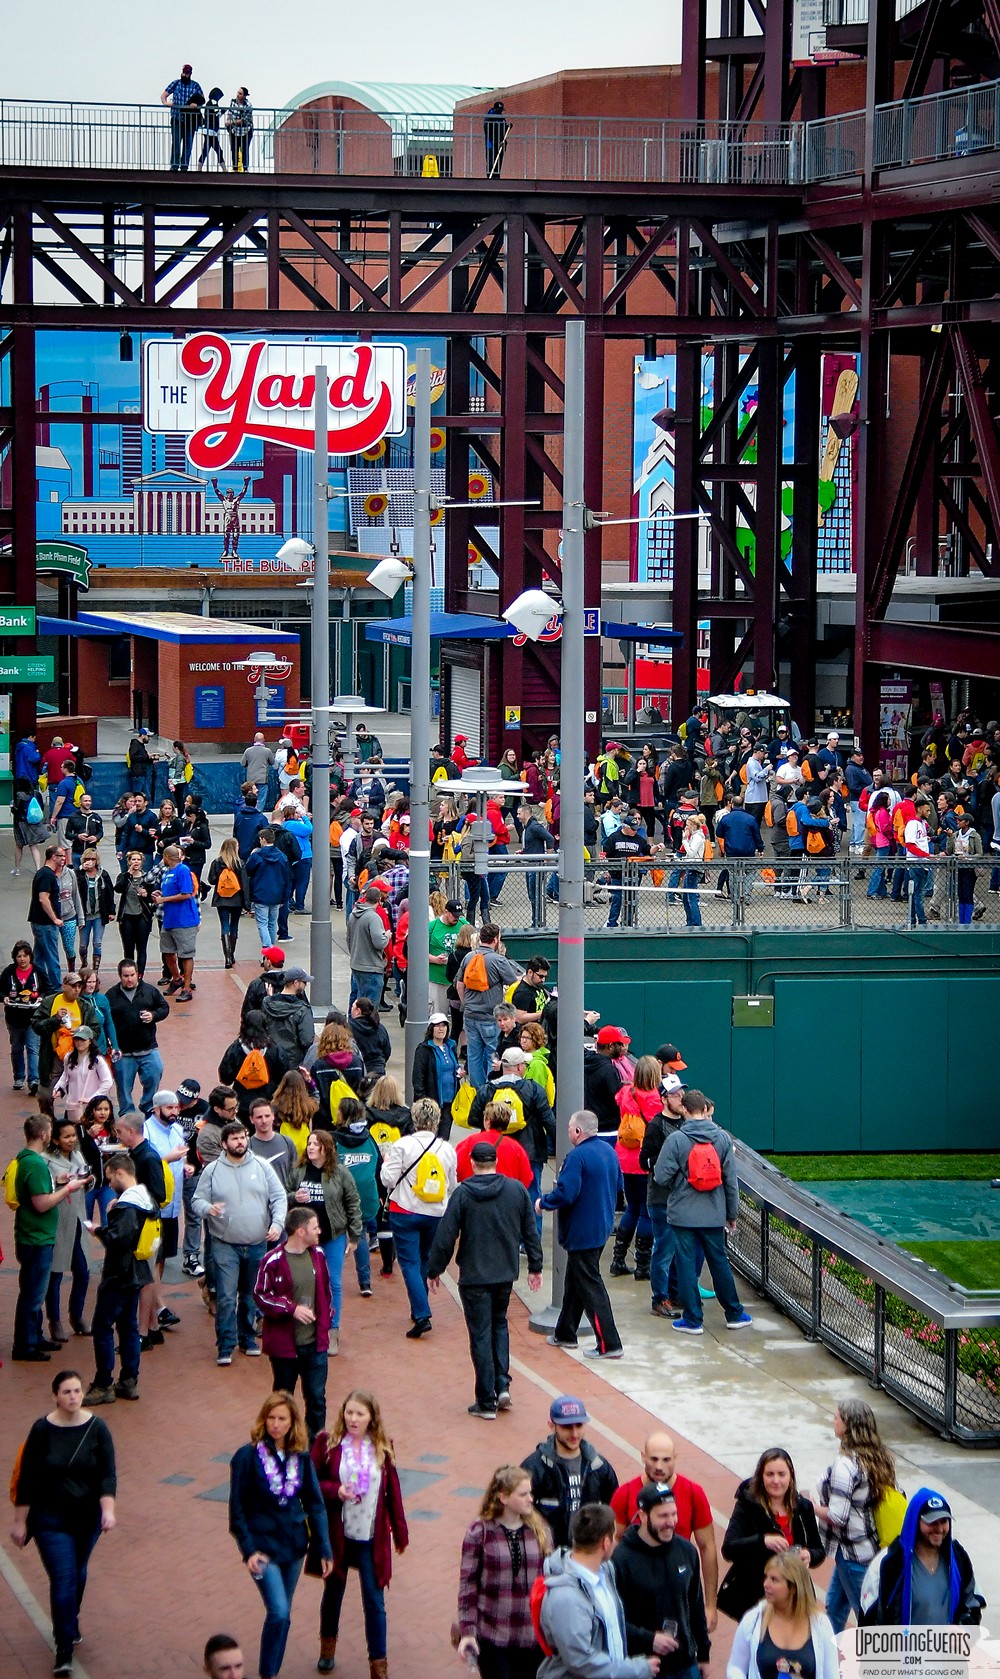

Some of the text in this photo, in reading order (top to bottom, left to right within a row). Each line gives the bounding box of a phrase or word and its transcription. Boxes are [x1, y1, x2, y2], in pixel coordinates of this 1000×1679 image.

[160, 332, 393, 471] THE Yard
[39, 552, 53, 561] Bank
[53, 552, 67, 563] Phan
[67, 554, 81, 566] Field
[222, 559, 253, 573] THE
[0, 615, 28, 627] Bank
[0, 667, 20, 675] Bank
[189, 663, 220, 671] WELCOME
[222, 663, 231, 671] TO
[344, 1153, 371, 1166] EAGLES
